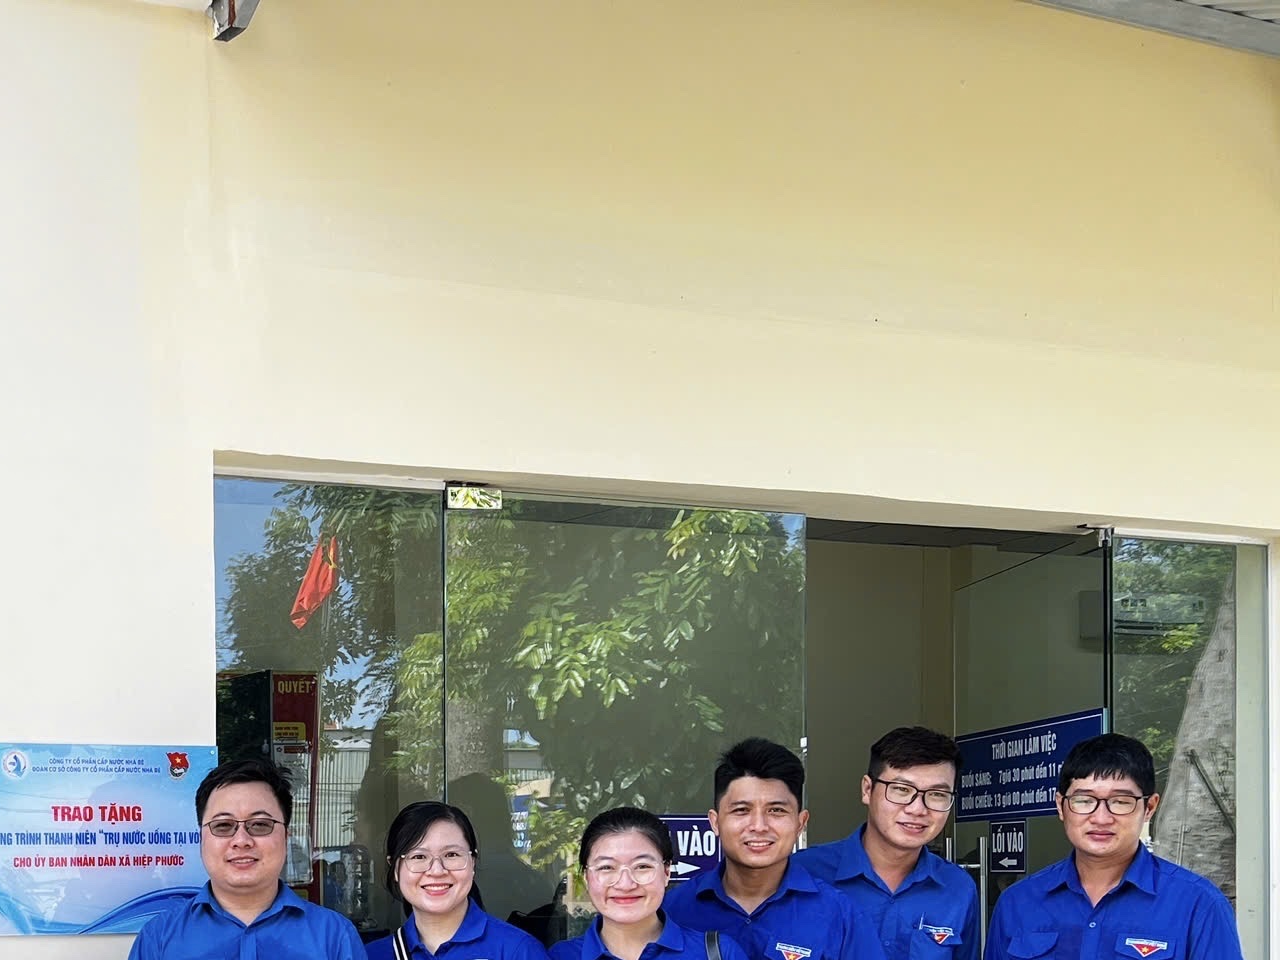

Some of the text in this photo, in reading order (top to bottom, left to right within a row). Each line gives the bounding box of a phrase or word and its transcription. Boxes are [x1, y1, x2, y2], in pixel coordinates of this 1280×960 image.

[278, 677, 311, 694] QUYẾT
[991, 730, 1057, 760] THỜI GIAN LÀM VIỆC
[97, 756, 108, 765] CẤP
[114, 764, 125, 773] CẤP
[1012, 768, 1020, 782] 30
[1021, 766, 1034, 782] phút
[1036, 761, 1048, 779] đến
[1048, 762, 1056, 778] 11
[994, 793, 1001, 807] 13
[1012, 791, 1020, 806] 00
[1021, 788, 1034, 806] phút
[1036, 786, 1048, 803] đến
[1048, 786, 1057, 802] 17
[51, 803, 142, 825] TRAO TẶNG
[14, 830, 42, 845] TRÌNH
[43, 832, 73, 845] THANH
[75, 829, 97, 845] NIÊN
[122, 828, 146, 844] NƯỚC
[148, 827, 172, 844] UỐNG
[173, 832, 187, 847] TẠI
[188, 829, 200, 844] VÒ
[676, 825, 716, 856] VÀO
[992, 824, 1024, 853] LỐI VÀO
[13, 854, 184, 868] CHO ỦY BAN NHÂN DÂN XÃ HIỆP PHƯỚC
